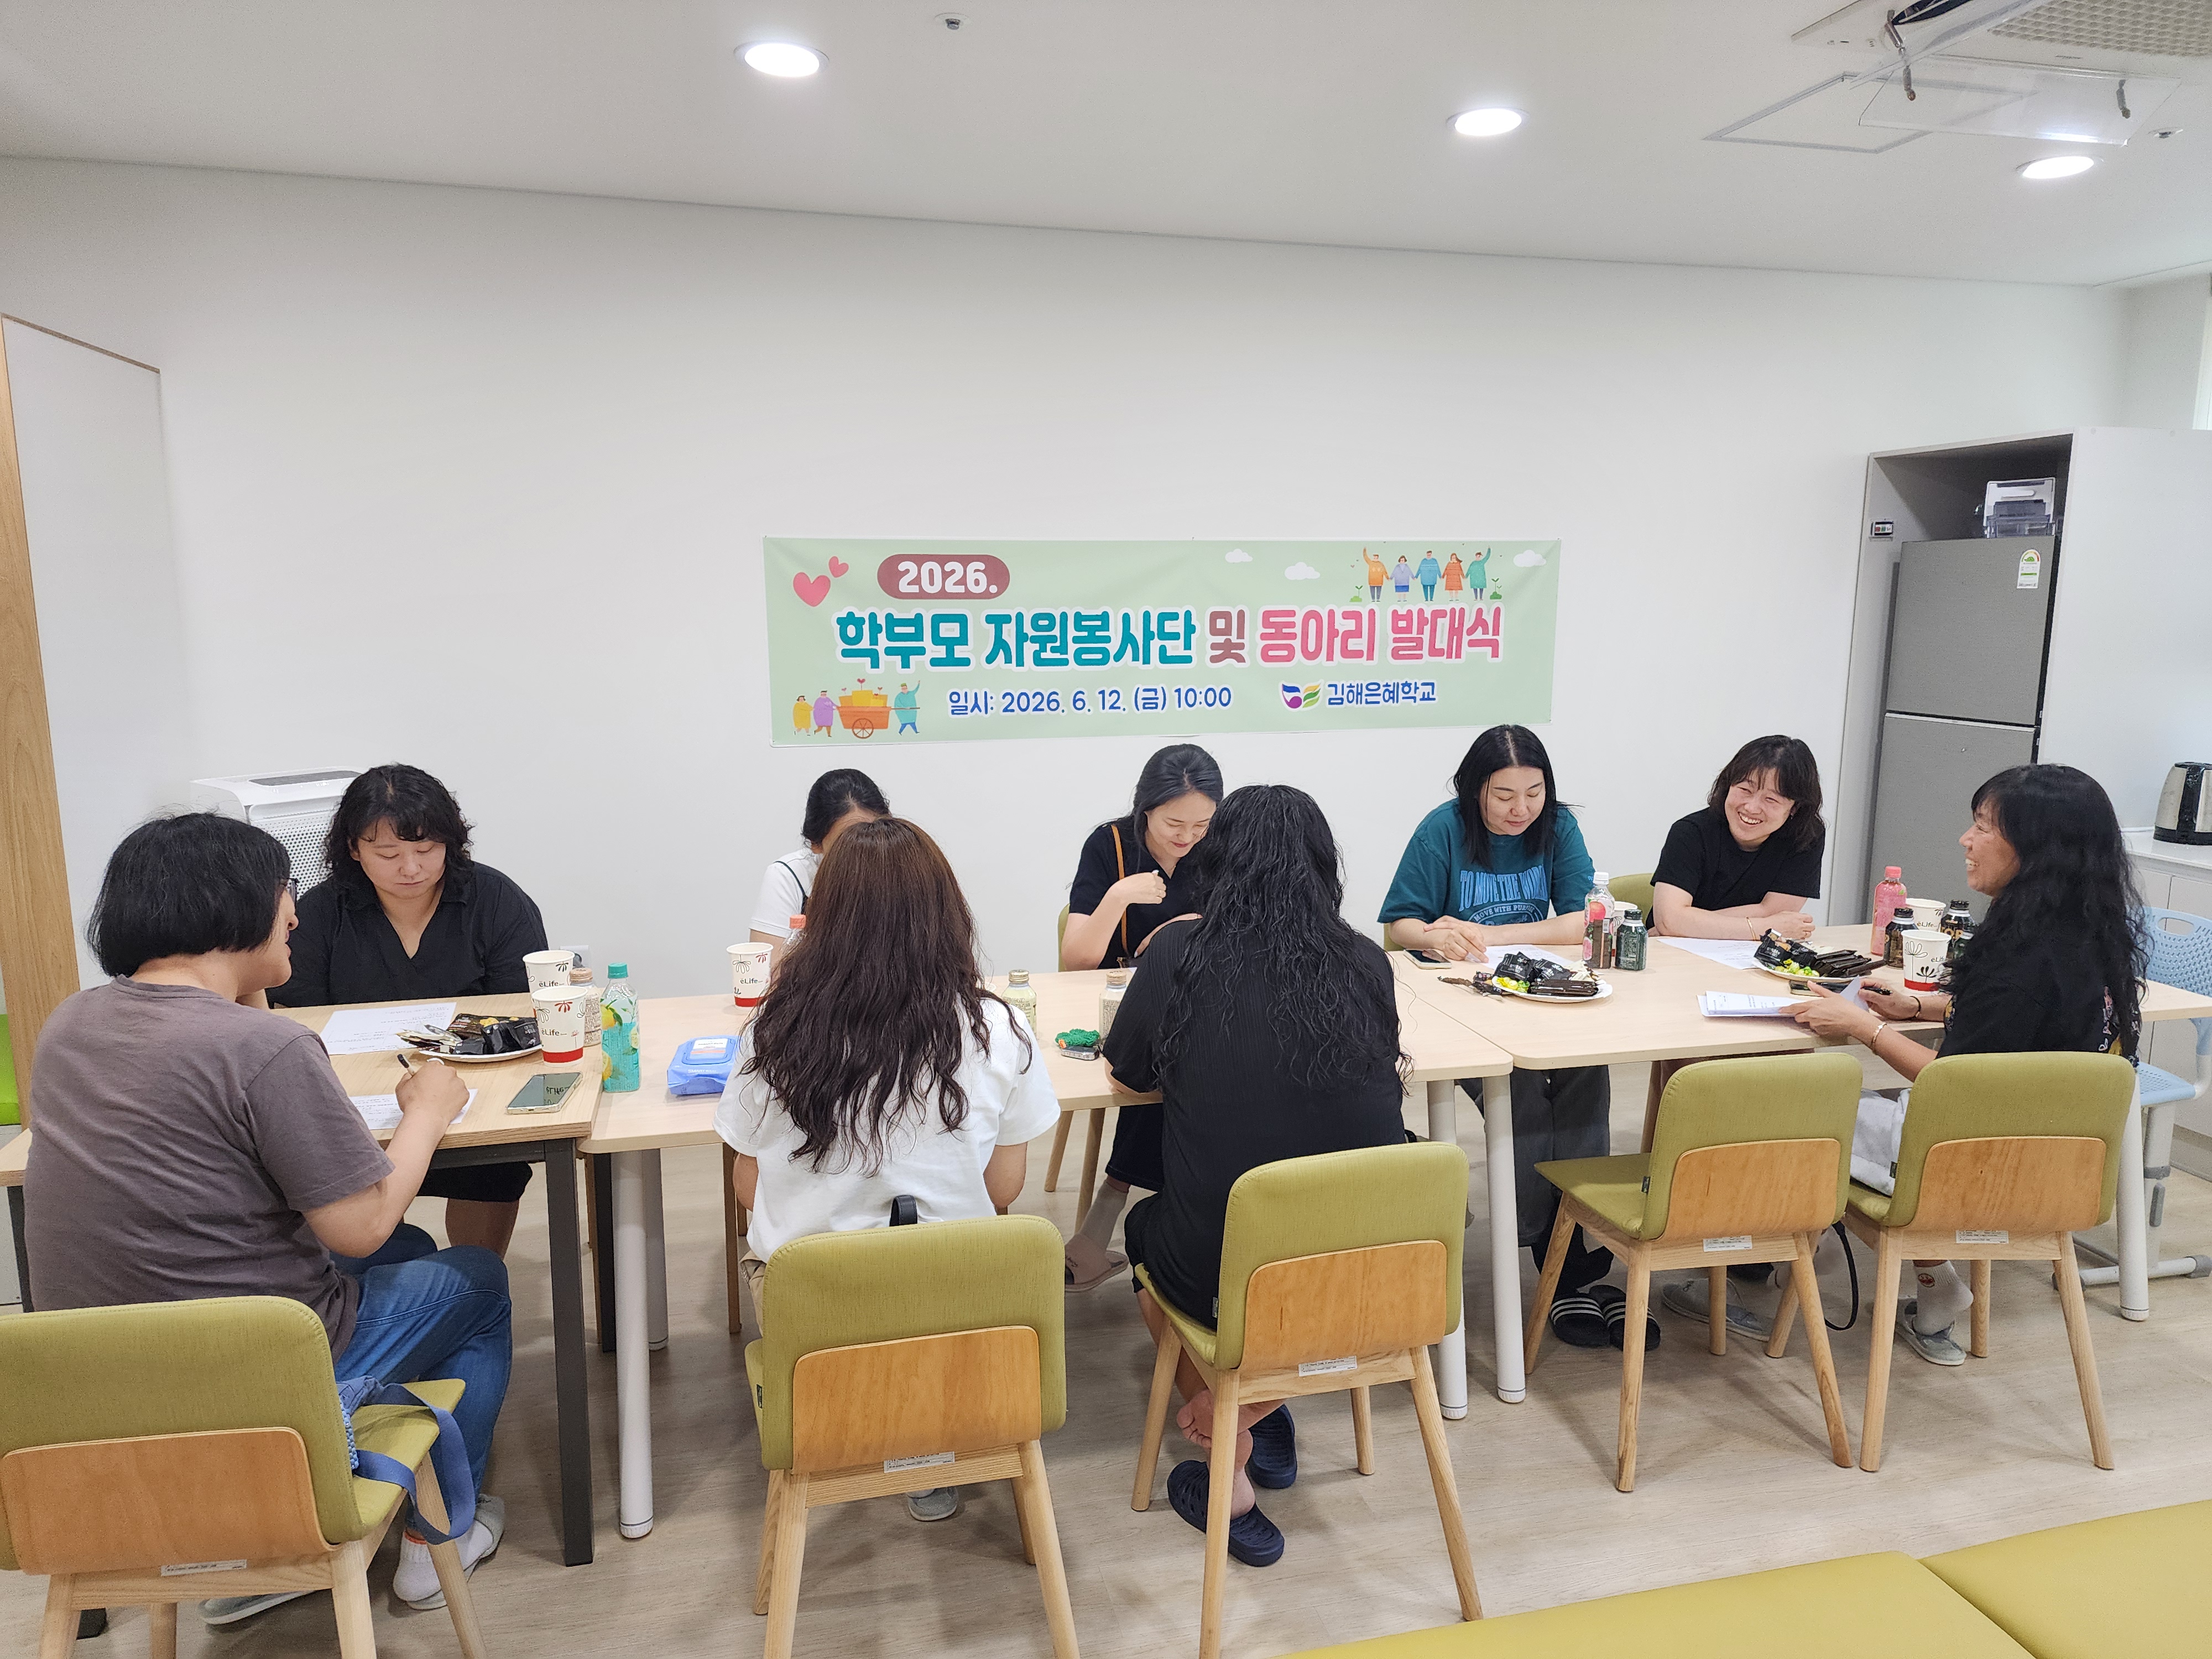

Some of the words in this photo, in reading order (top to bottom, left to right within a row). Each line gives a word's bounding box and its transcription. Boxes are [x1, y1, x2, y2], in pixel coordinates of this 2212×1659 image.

[898, 561, 998, 593] 2026.
[836, 611, 971, 670] 학부모
[984, 609, 1197, 667] 자원봉사단
[1209, 609, 1246, 664] 및
[1260, 608, 1376, 663] 동아리
[1391, 606, 1501, 660] 발대식
[949, 691, 994, 716] 일시:
[1001, 691, 1065, 713] 2026.
[1072, 690, 1091, 712] 6.
[1098, 689, 1126, 712] 12.
[1134, 686, 1167, 712] (금)
[1173, 687, 1232, 708] 10:00
[1327, 681, 1437, 706] 김해은혜학교
[1458, 870, 1474, 912] TO
[1473, 872, 1499, 906] MOVE
[1496, 874, 1521, 902] THE
[1473, 909, 1494, 922] MOVE
